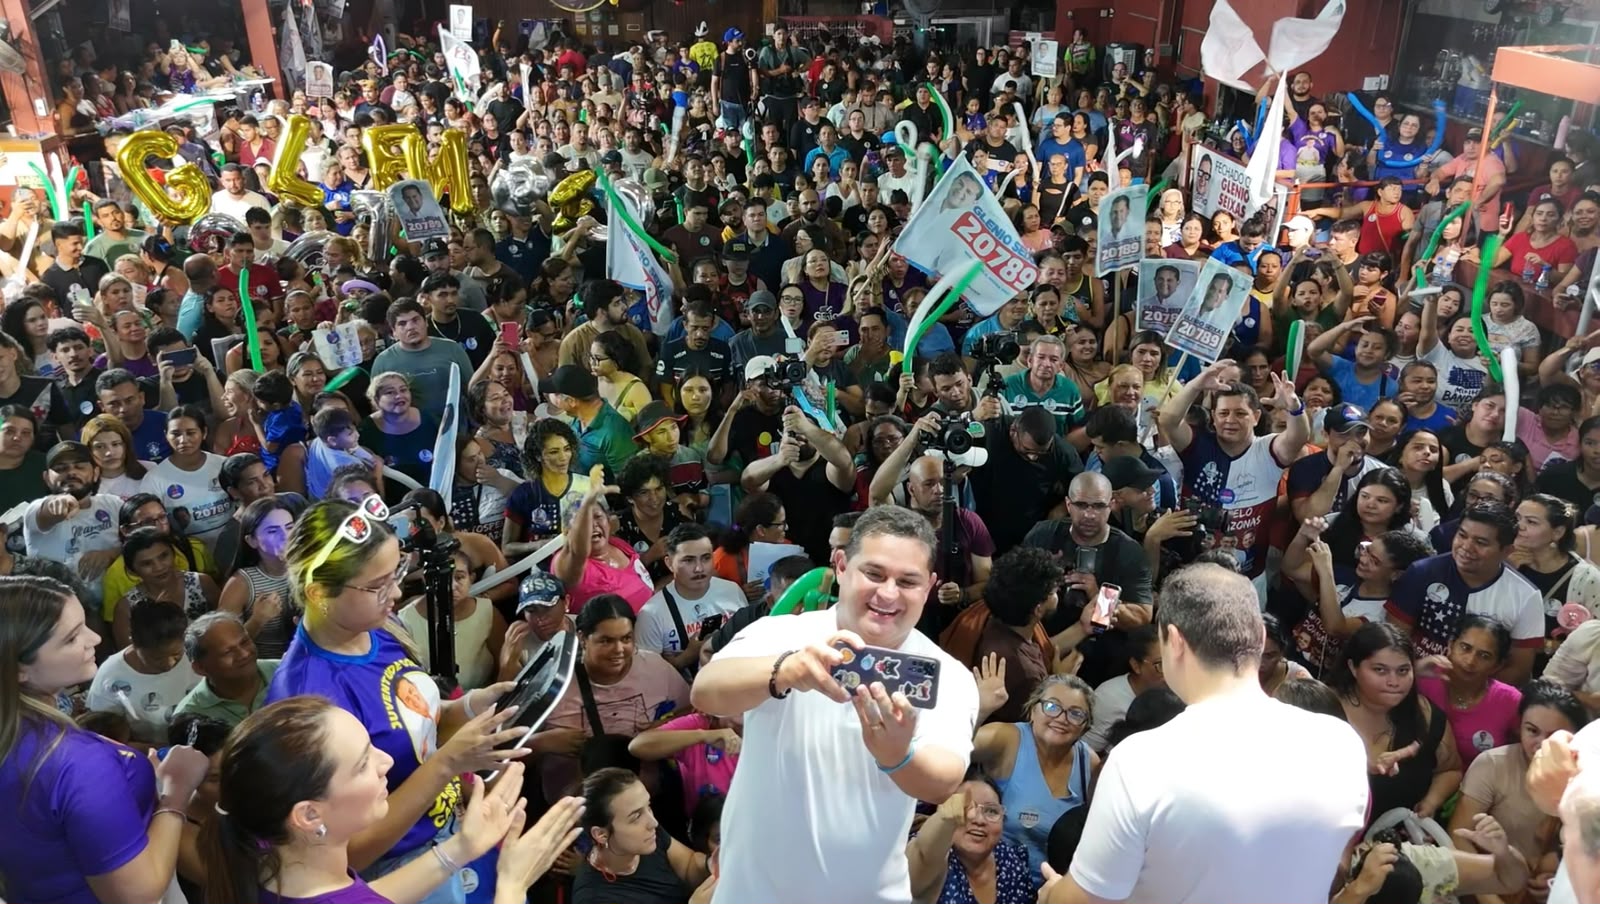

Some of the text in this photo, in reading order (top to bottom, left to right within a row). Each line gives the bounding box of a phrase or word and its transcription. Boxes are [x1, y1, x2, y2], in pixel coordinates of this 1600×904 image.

[1214, 160, 1243, 186] FECHADO
[1220, 178, 1250, 204] GLENIO
[1217, 193, 1247, 218] SEIXAS
[406, 220, 443, 232] 20789
[972, 205, 1013, 247] GLENIO
[956, 214, 1038, 289] 20789
[1102, 241, 1139, 261] 20789
[1143, 310, 1181, 322] 2078
[1177, 321, 1220, 348] 20789
[1230, 507, 1253, 519] ELO
